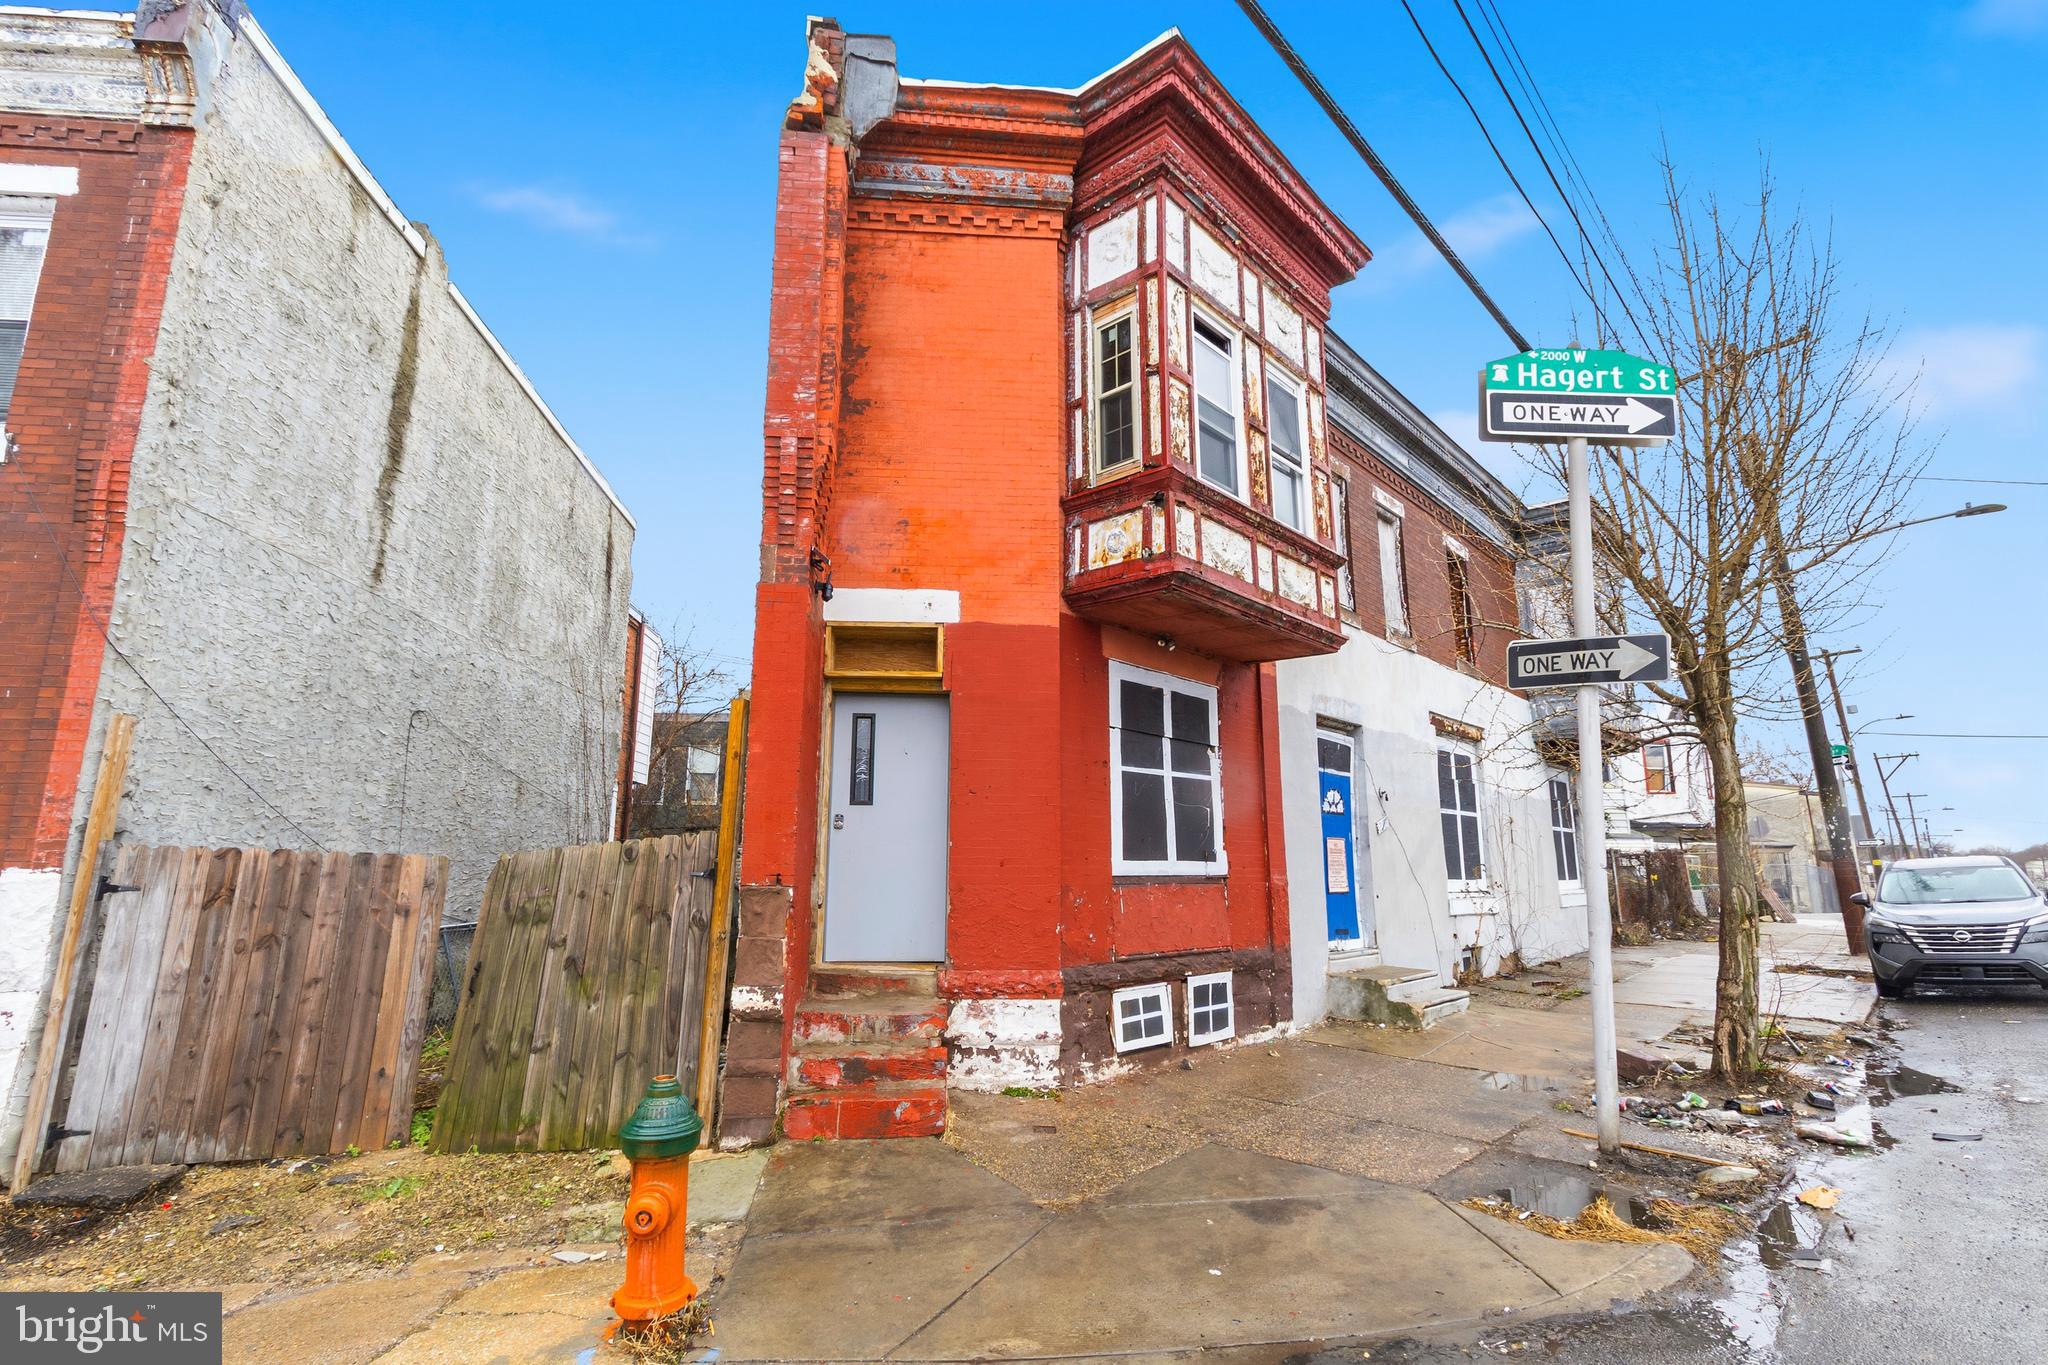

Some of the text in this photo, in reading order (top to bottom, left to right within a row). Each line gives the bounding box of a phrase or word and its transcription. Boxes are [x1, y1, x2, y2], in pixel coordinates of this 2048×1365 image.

[1540, 350, 1587, 363] 2000 W
[1518, 363, 1670, 392] Hagert St
[1513, 405, 1621, 423] ONE WAY
[1523, 651, 1615, 674] ONE WAY
